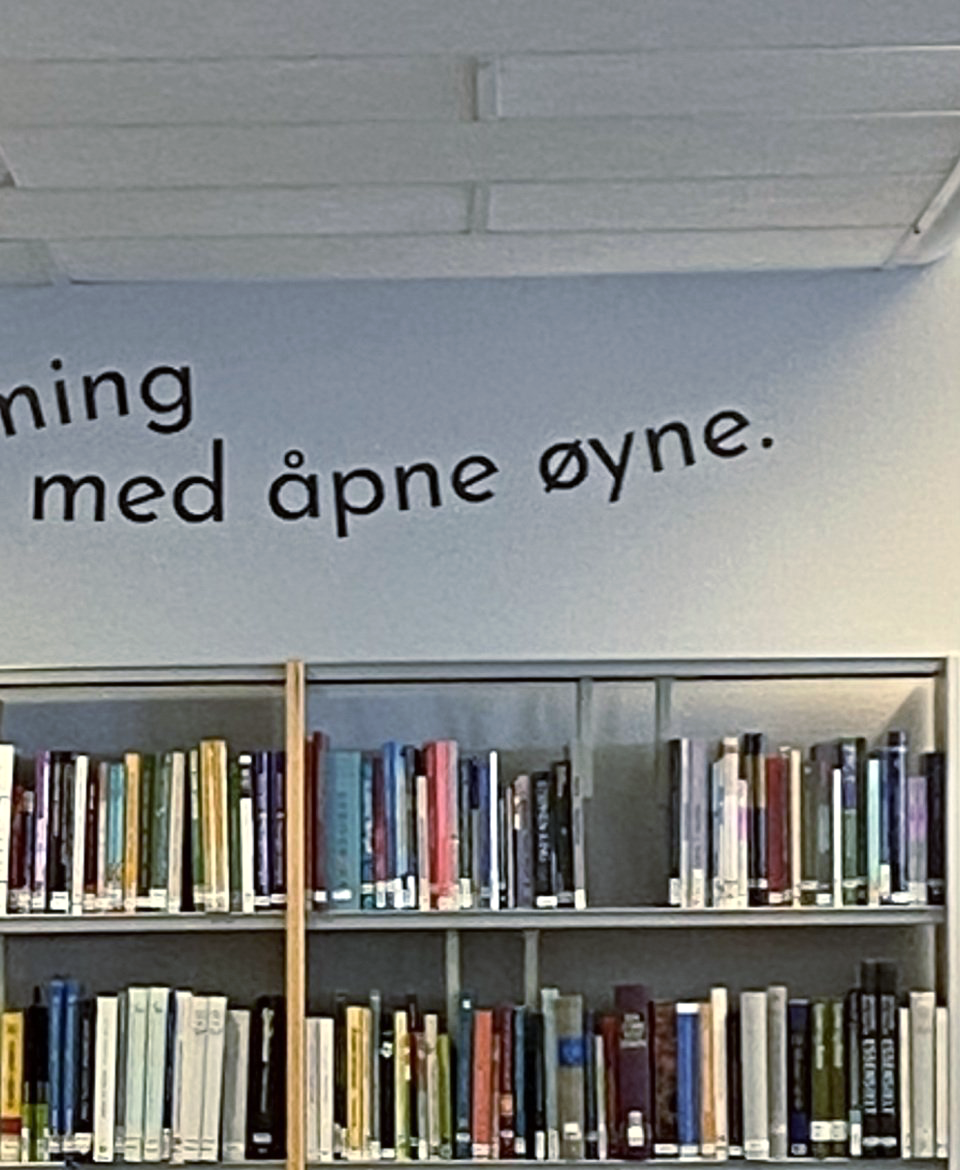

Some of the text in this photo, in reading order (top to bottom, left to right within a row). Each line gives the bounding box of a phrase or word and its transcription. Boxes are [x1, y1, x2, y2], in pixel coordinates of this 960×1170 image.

[32, 410, 773, 538] med åpne øyne.
